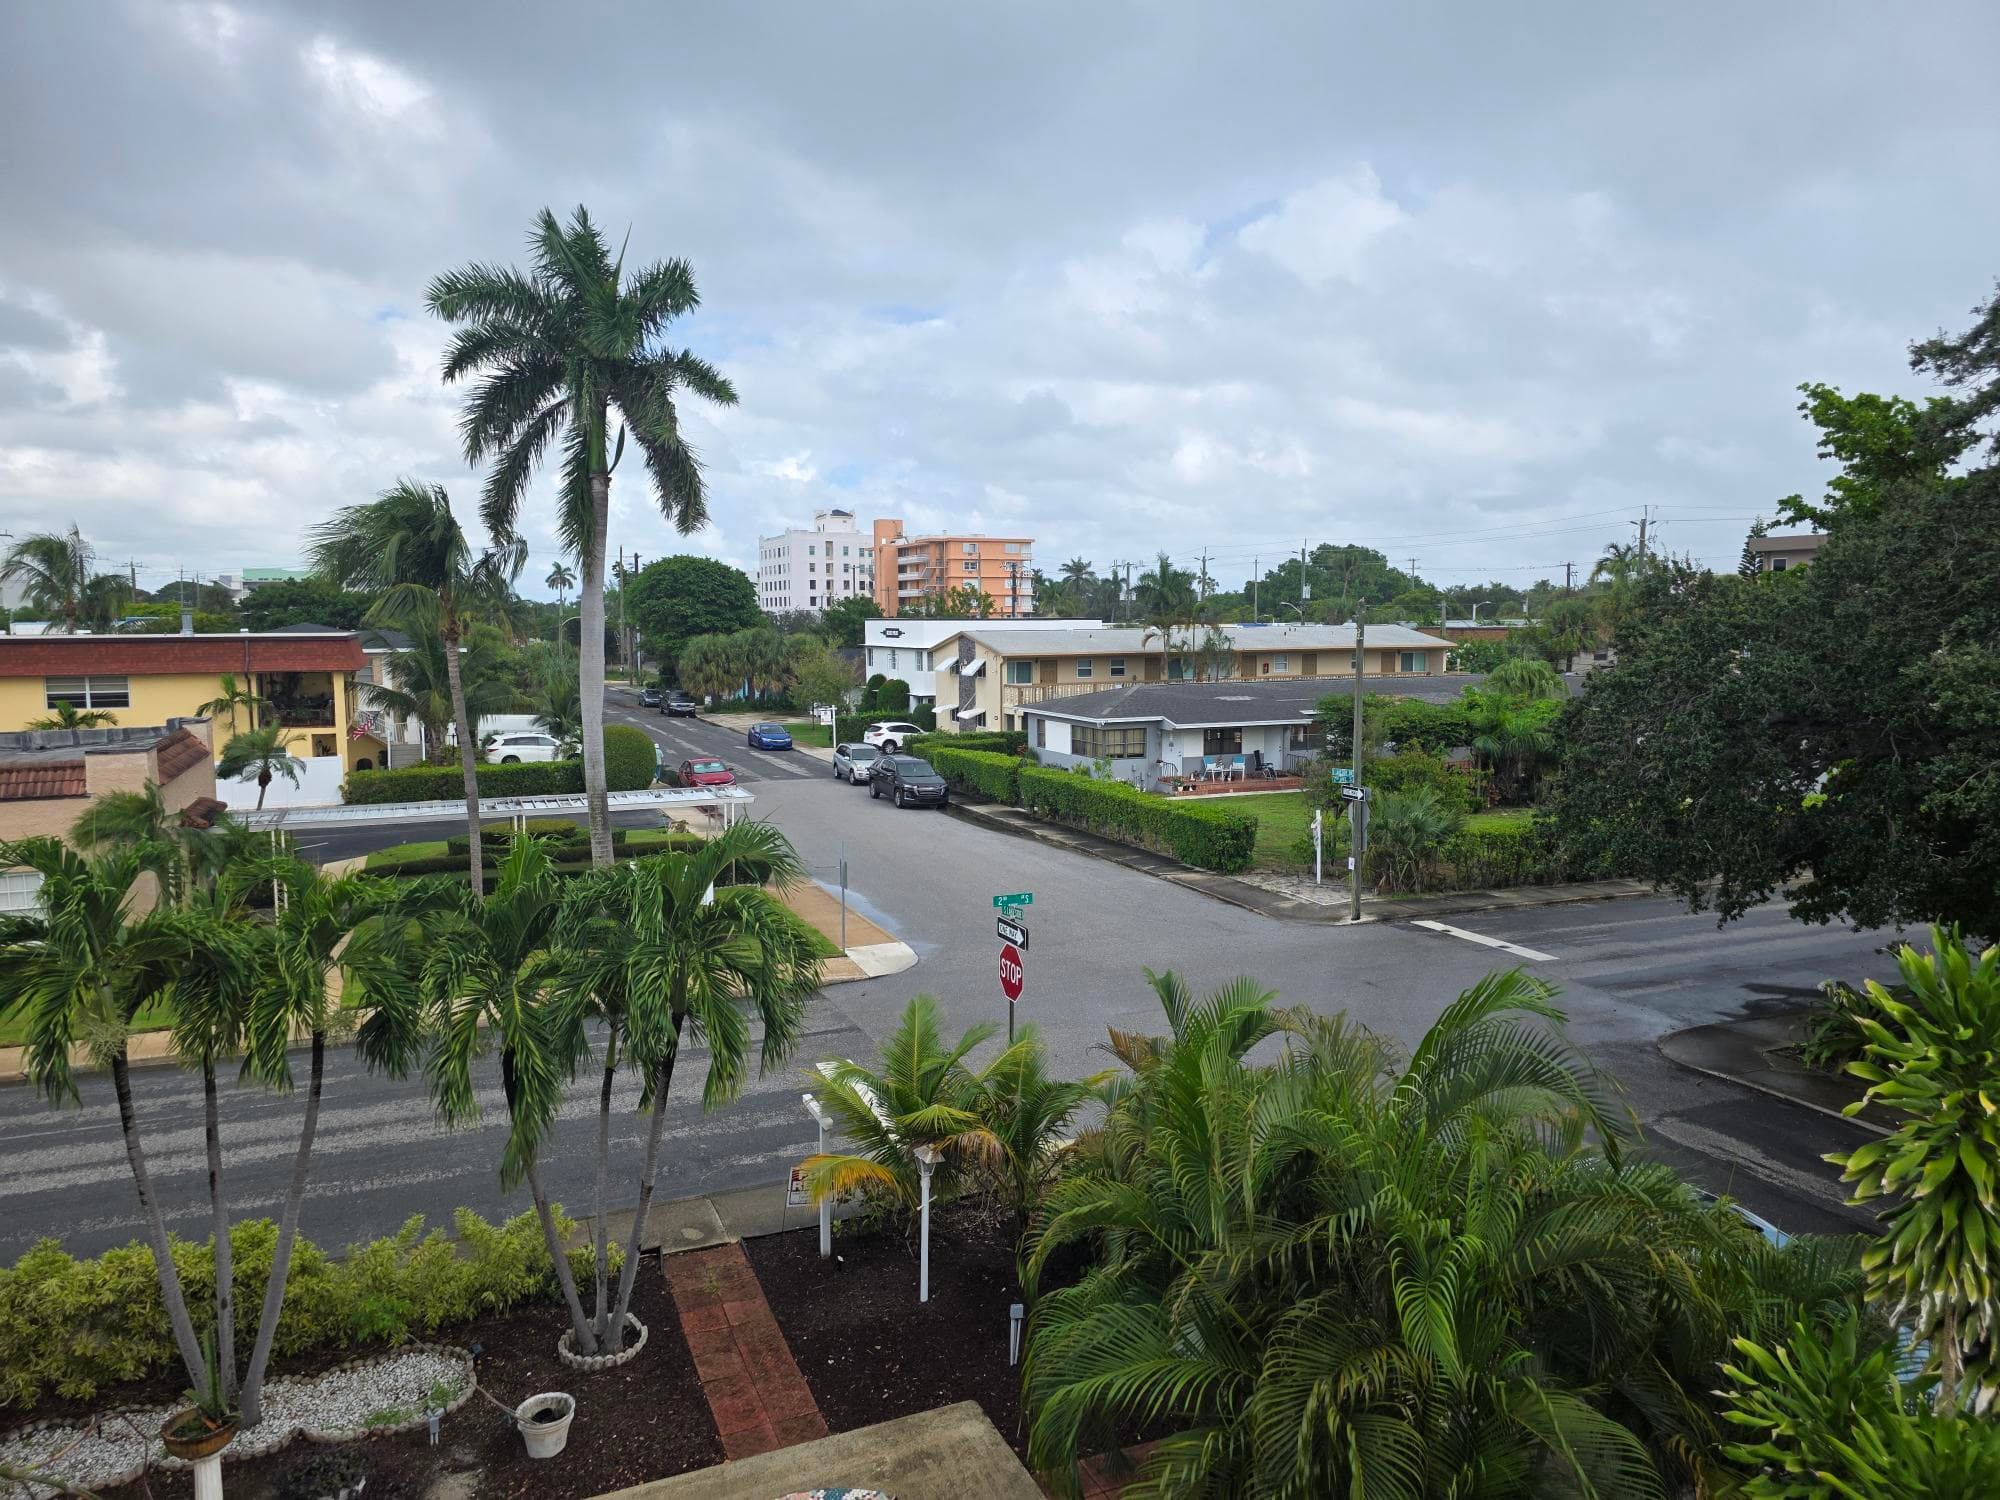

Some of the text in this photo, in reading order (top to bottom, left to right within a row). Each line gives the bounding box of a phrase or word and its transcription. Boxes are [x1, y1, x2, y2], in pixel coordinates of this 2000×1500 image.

[1000, 924, 1017, 939] ONE WAY
[1001, 958, 1021, 985] STOP
